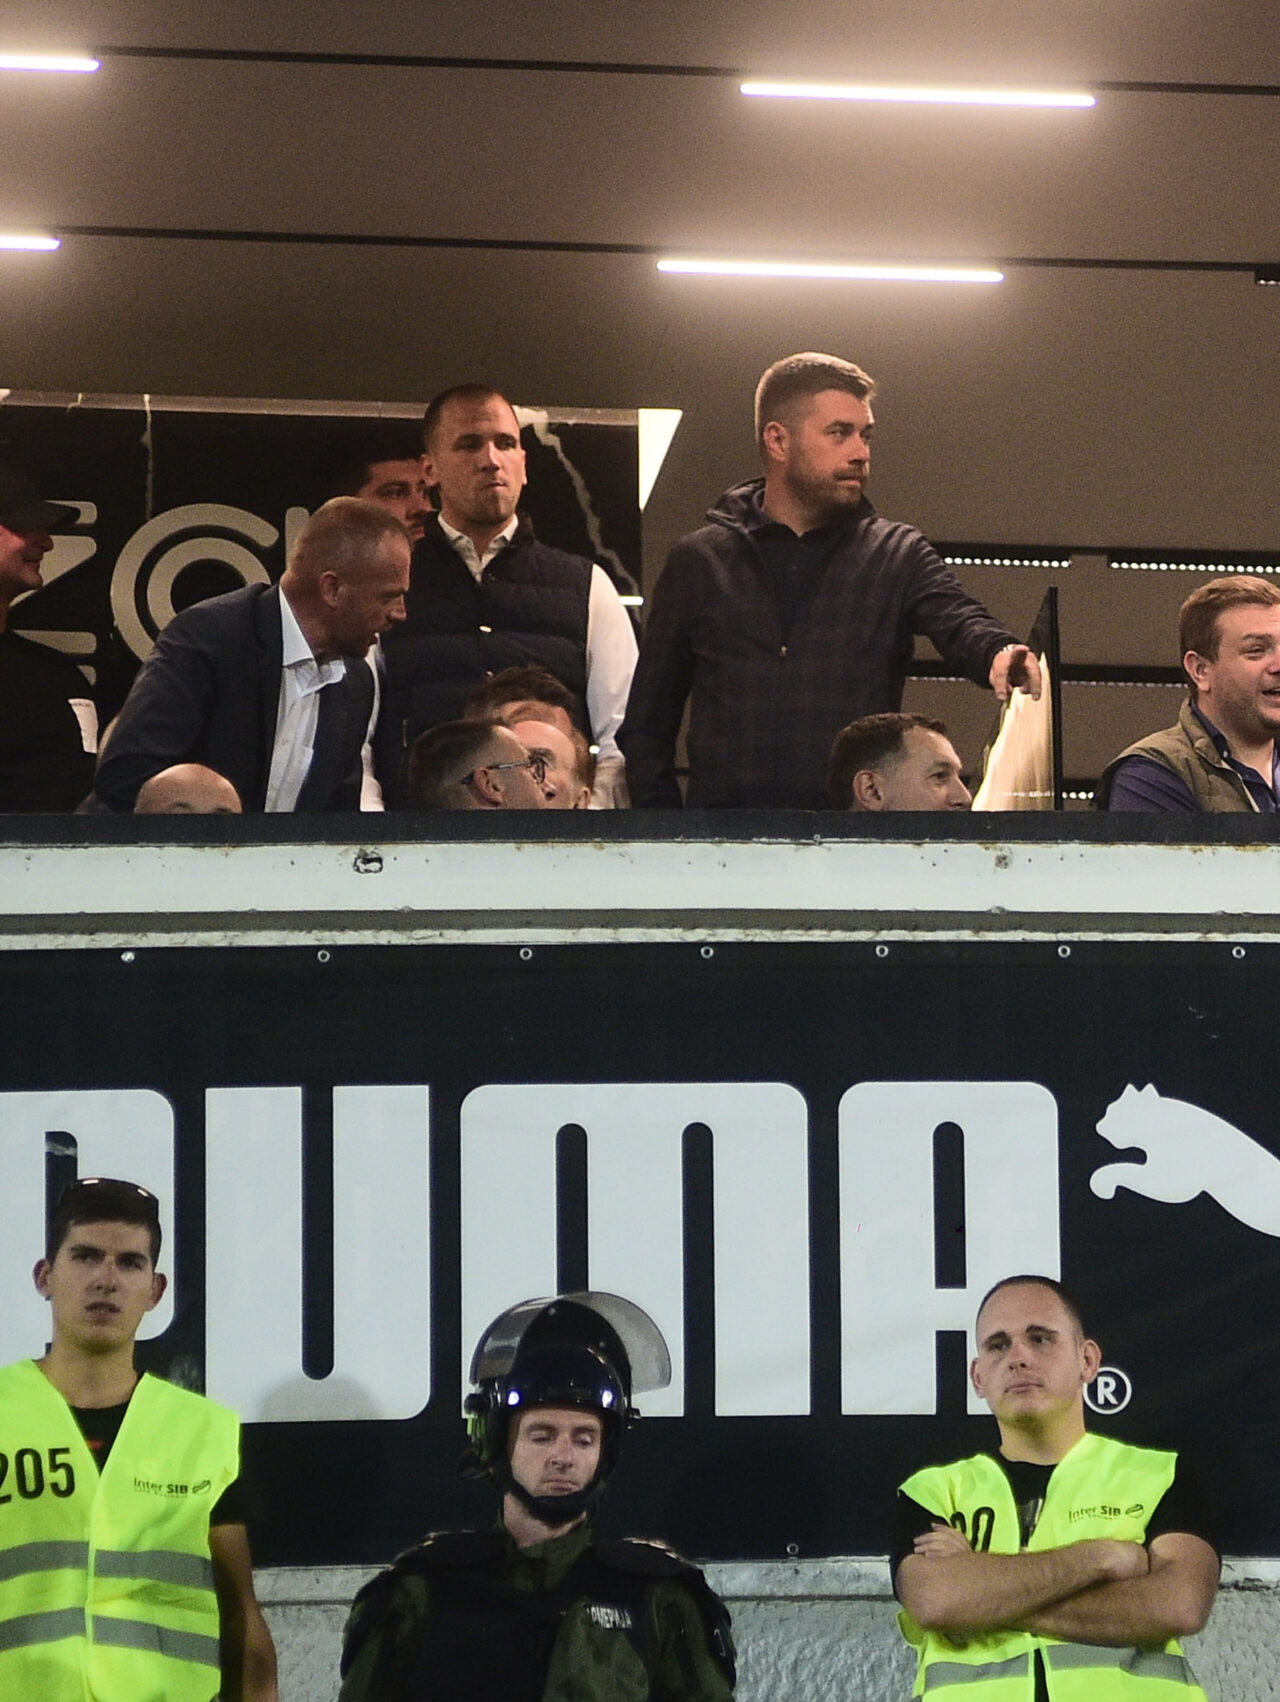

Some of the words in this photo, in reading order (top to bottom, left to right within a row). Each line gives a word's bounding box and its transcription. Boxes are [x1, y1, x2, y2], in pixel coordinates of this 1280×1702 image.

[0, 1081, 1061, 1424] PUMA
[0, 1447, 76, 1505] 205
[133, 1477, 162, 1491] Inter
[167, 1483, 188, 1494] SIB
[1068, 1506, 1096, 1521] Inter
[1101, 1505, 1121, 1517] SIB
